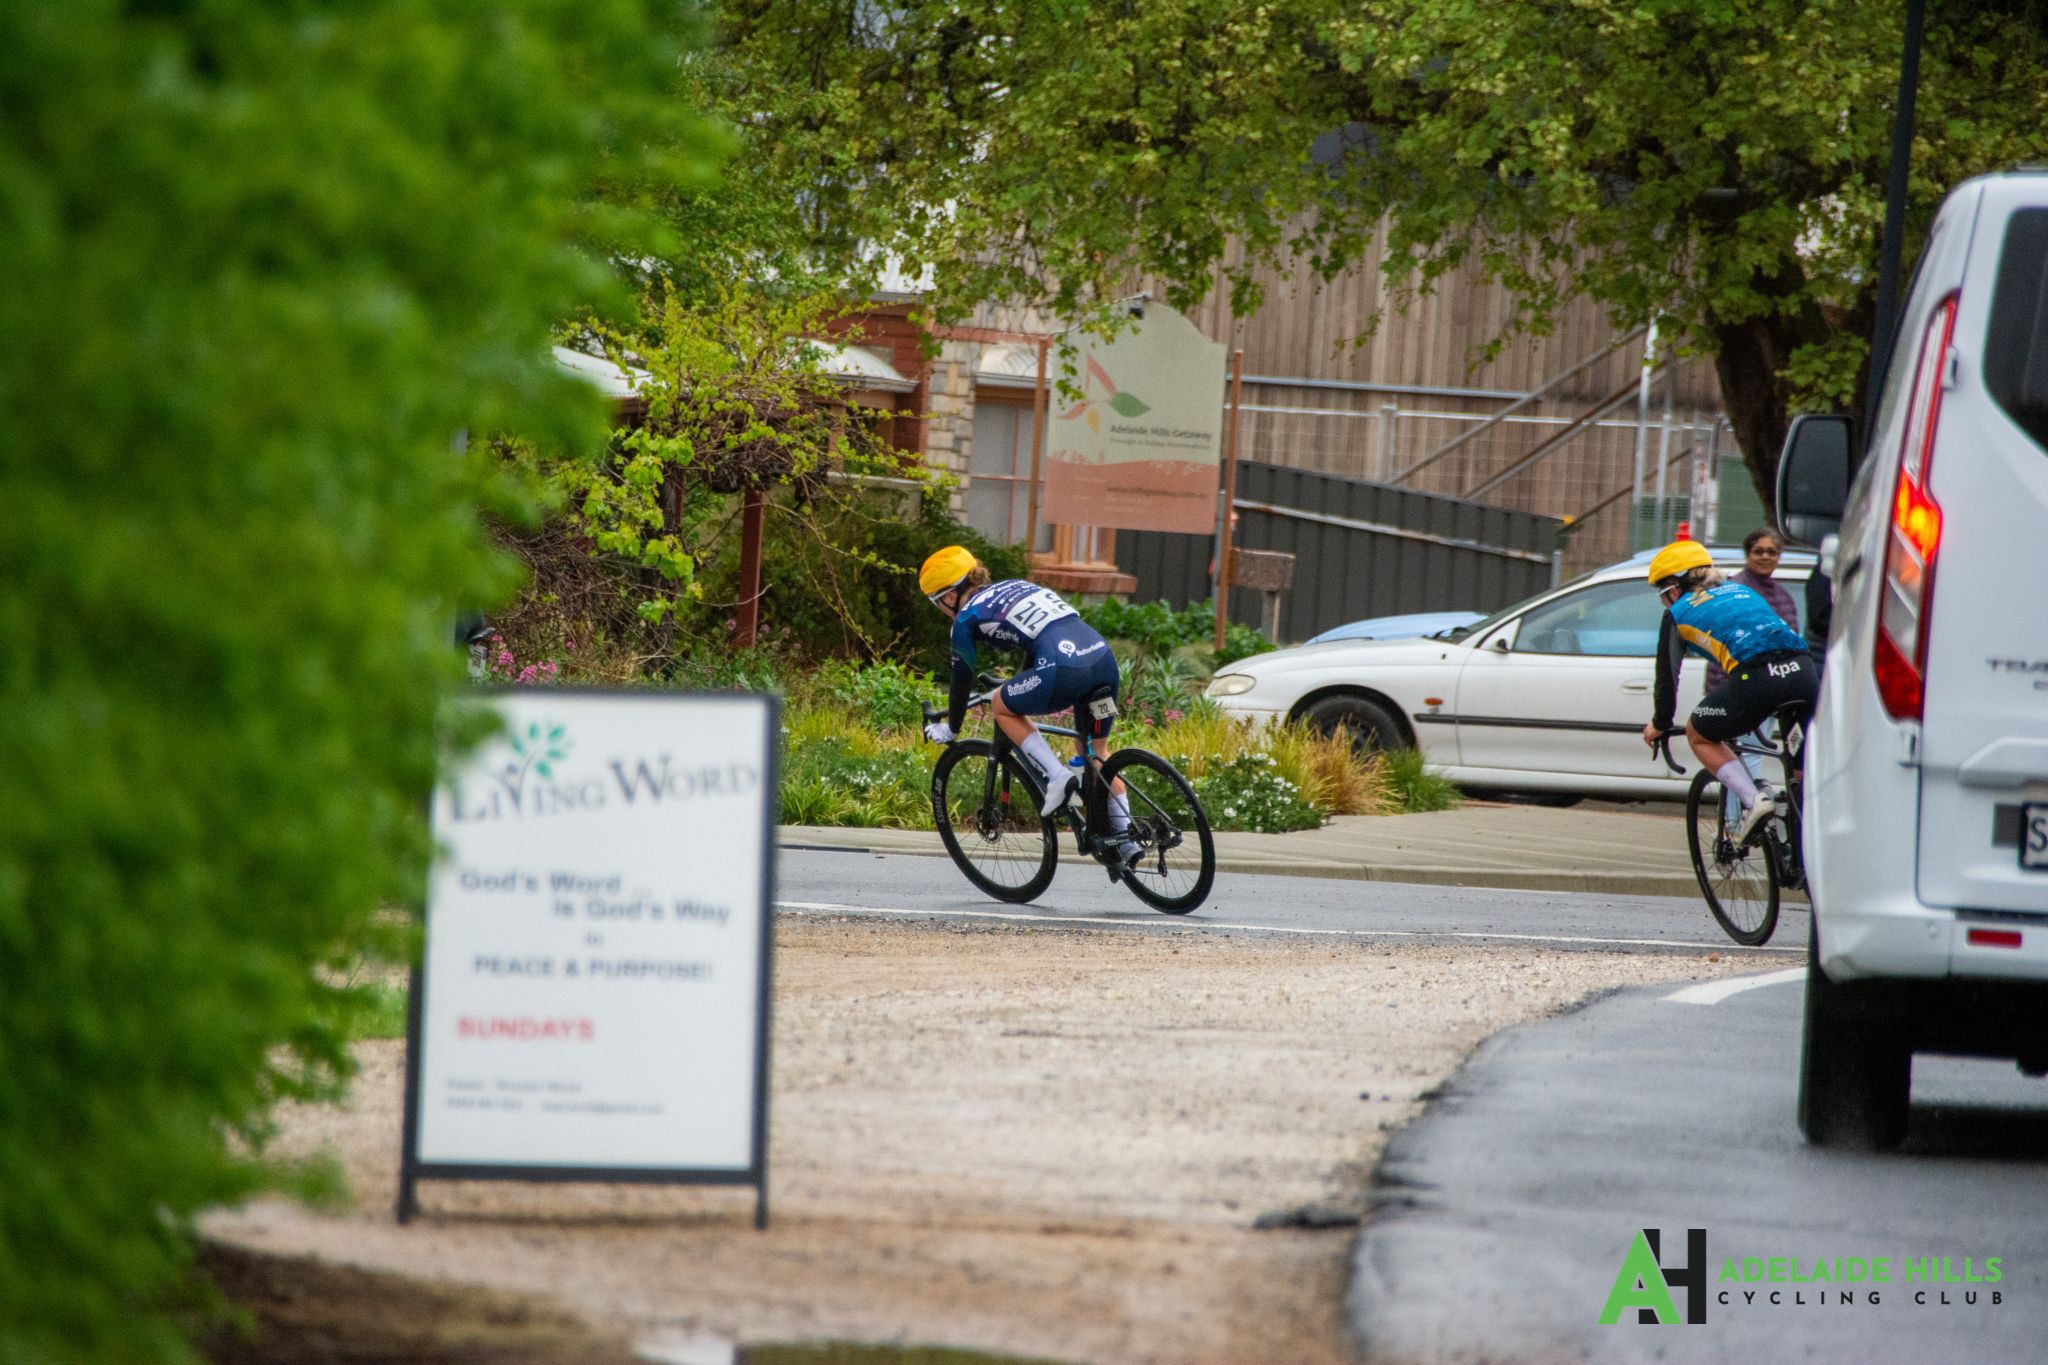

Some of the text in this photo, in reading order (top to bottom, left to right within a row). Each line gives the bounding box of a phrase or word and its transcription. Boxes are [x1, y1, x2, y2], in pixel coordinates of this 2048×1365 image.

[1110, 424, 1148, 436] Adelaide
[1013, 601, 1049, 632] 212
[1768, 660, 1801, 678] kpa
[1007, 675, 1042, 697] Butterfields
[1693, 706, 1728, 718] eystone
[2029, 815, 2048, 852] S
[459, 870, 622, 895] God's Word
[585, 899, 665, 920] God's
[674, 901, 732, 926] Way
[474, 956, 556, 978] PEACE
[564, 958, 581, 977] &
[456, 1017, 595, 1041] SUNDAYS
